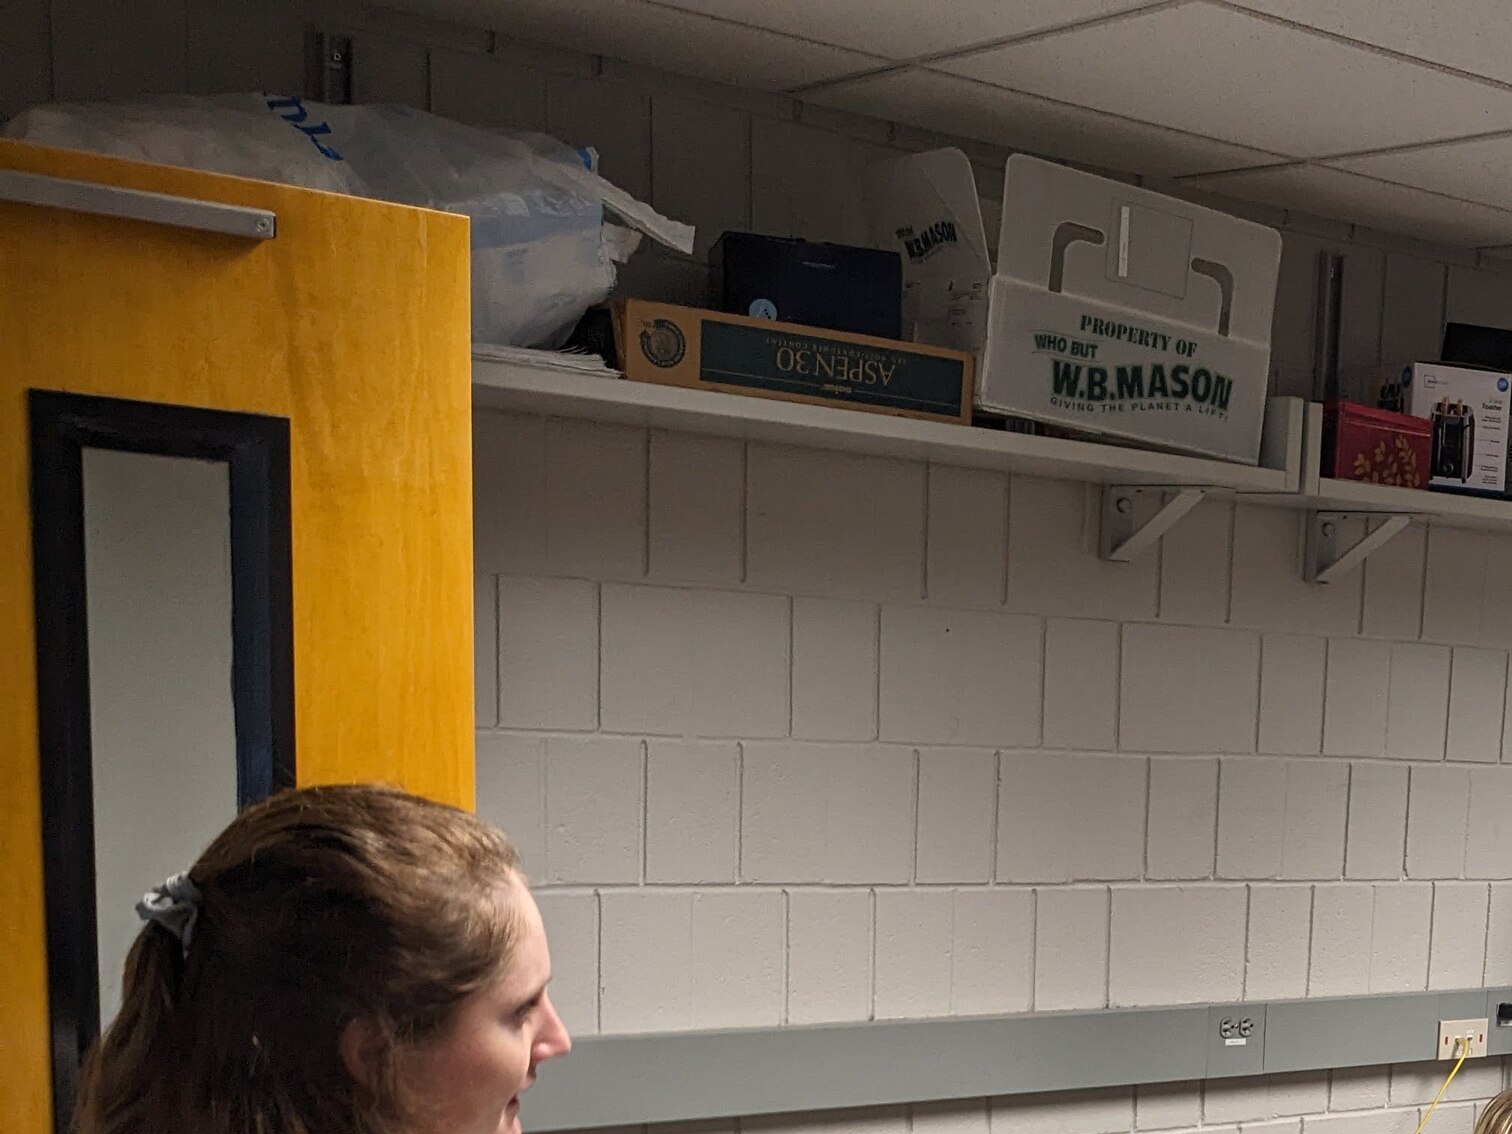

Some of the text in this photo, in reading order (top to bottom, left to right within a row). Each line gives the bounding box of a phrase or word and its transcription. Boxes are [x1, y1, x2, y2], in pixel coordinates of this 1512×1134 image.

[1034, 333, 1098, 359] WHO BUT
[1079, 314, 1198, 358] PROPERTY OF
[776, 346, 896, 386] ASPEN 30
[1052, 359, 1233, 411] W.B.MASON
[1050, 396, 1094, 412] GIVING
[1101, 403, 1124, 413] THE
[1131, 402, 1179, 412] PLANET
[1185, 404, 1193, 412] A
[1482, 402, 1503, 412] Toaster
